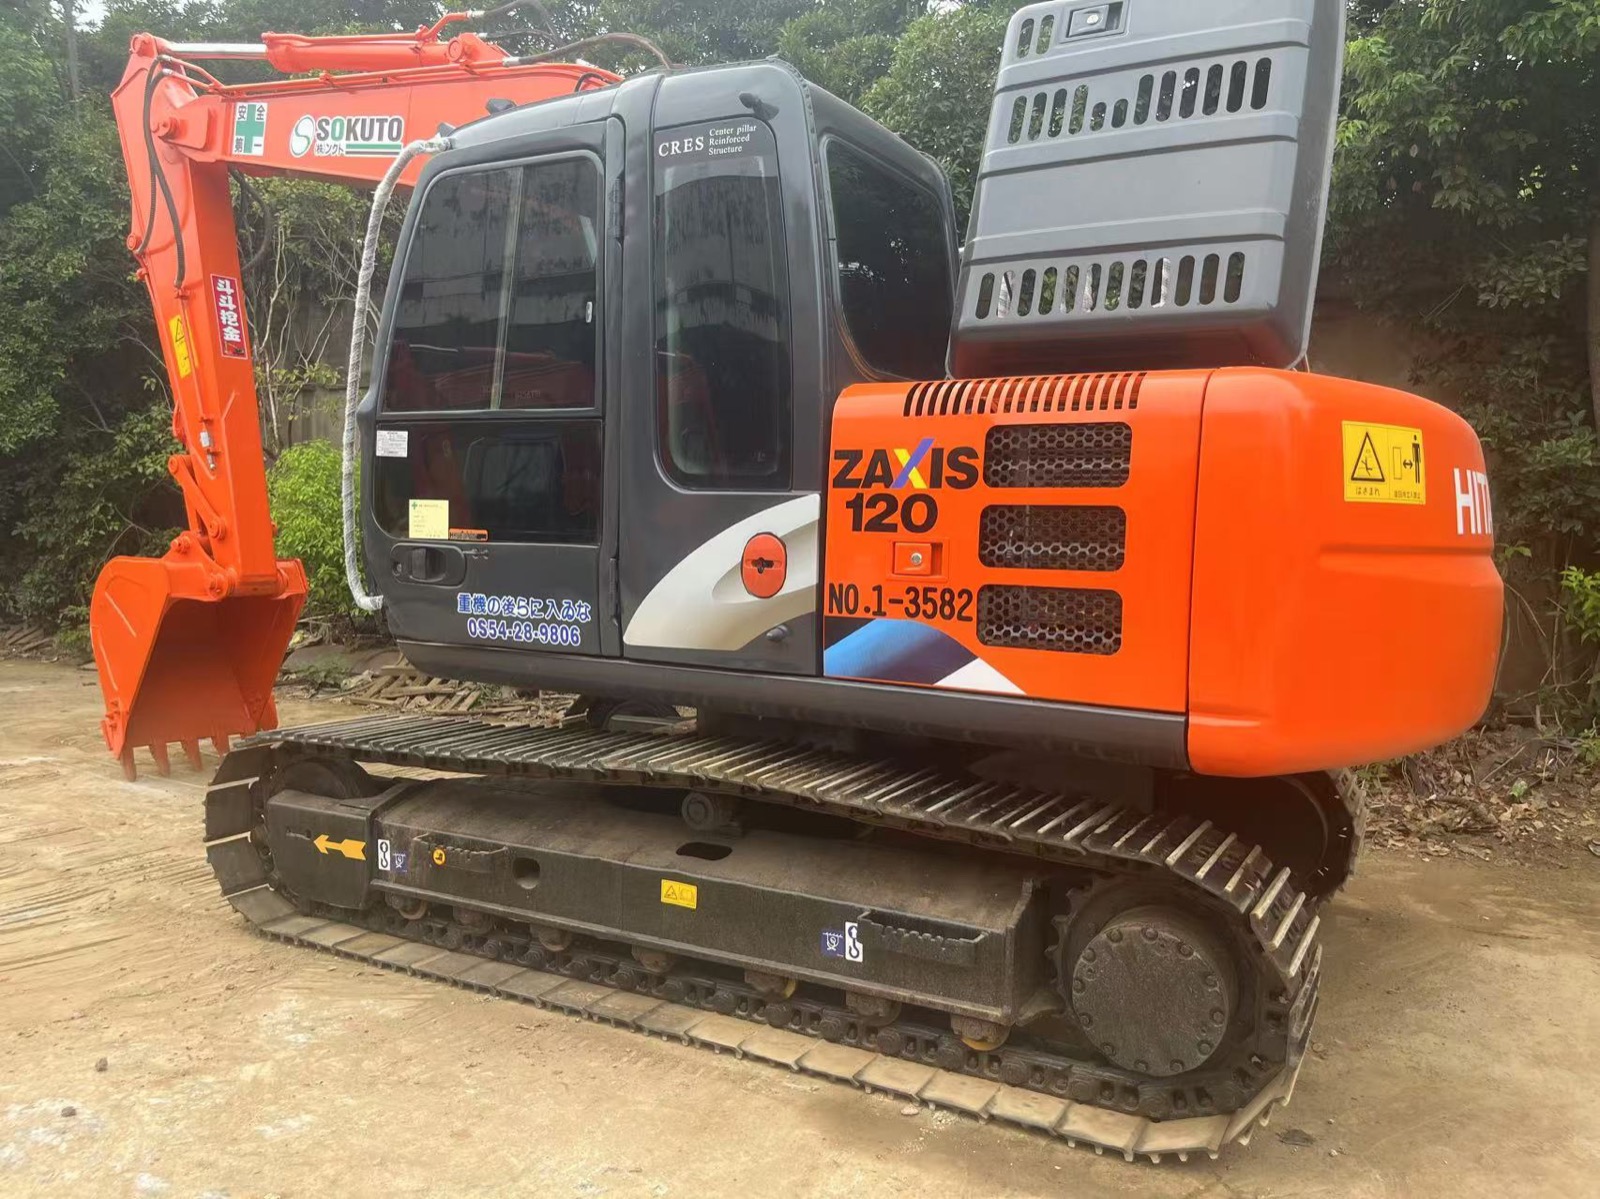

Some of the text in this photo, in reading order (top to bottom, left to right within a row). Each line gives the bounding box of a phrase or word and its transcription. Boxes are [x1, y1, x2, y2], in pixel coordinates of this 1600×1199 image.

[316, 117, 402, 142] SOKUTO
[709, 124, 757, 137] Center pillar
[709, 134, 750, 146] Reinforced
[658, 136, 704, 157] CRES
[708, 145, 743, 156] Structure
[832, 437, 980, 490] ZAXIS
[845, 492, 939, 534] 120
[828, 582, 974, 622] NO.1-3582
